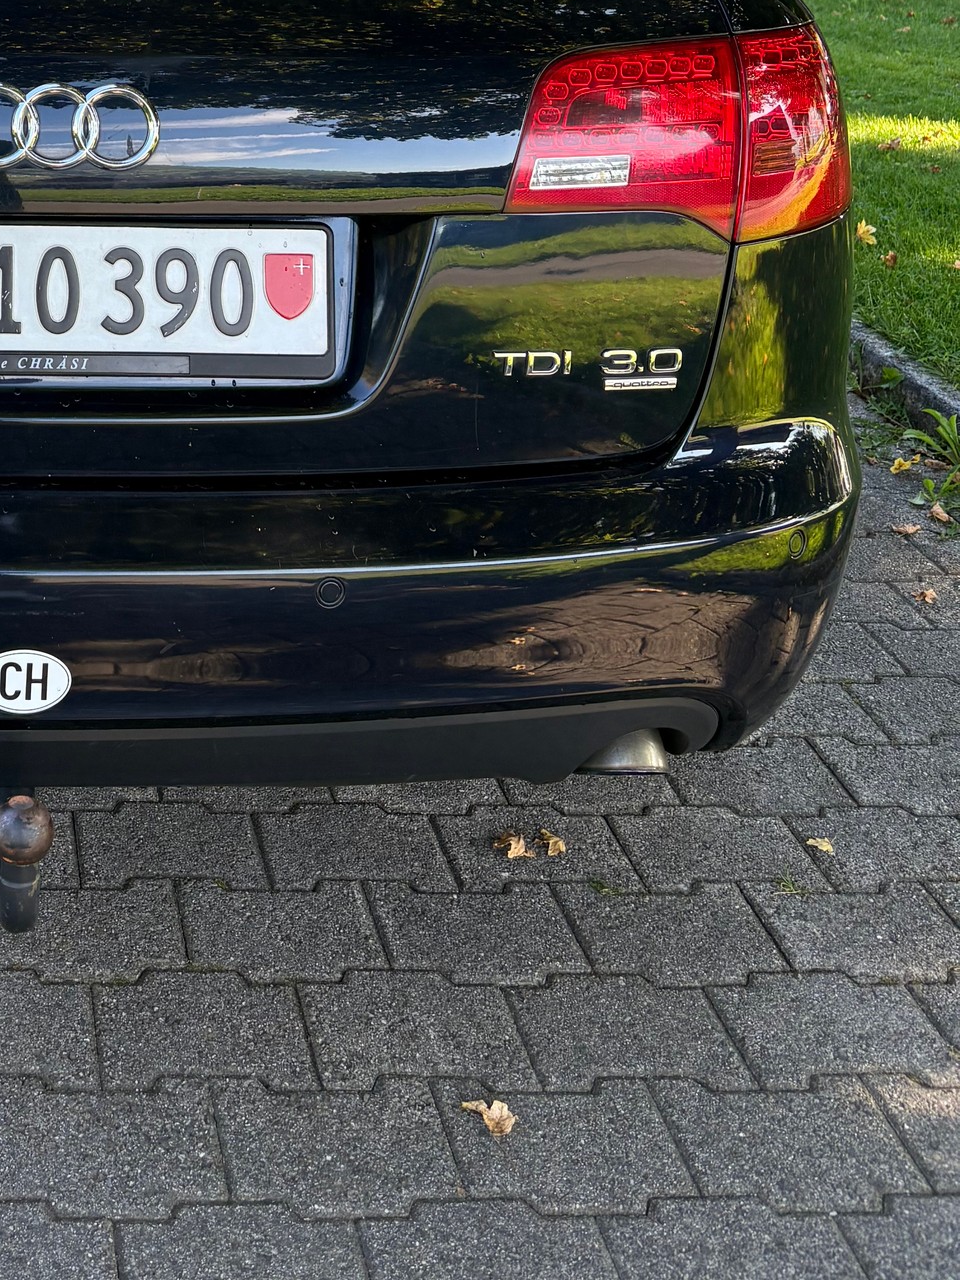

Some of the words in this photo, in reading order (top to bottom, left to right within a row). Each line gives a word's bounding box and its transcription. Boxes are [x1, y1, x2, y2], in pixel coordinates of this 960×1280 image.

[17, 355, 89, 370] CHRÄSI
[493, 349, 572, 377] TDI
[600, 347, 683, 375] 3.0
[613, 380, 669, 388] quattro
[0, 661, 49, 701] CH
